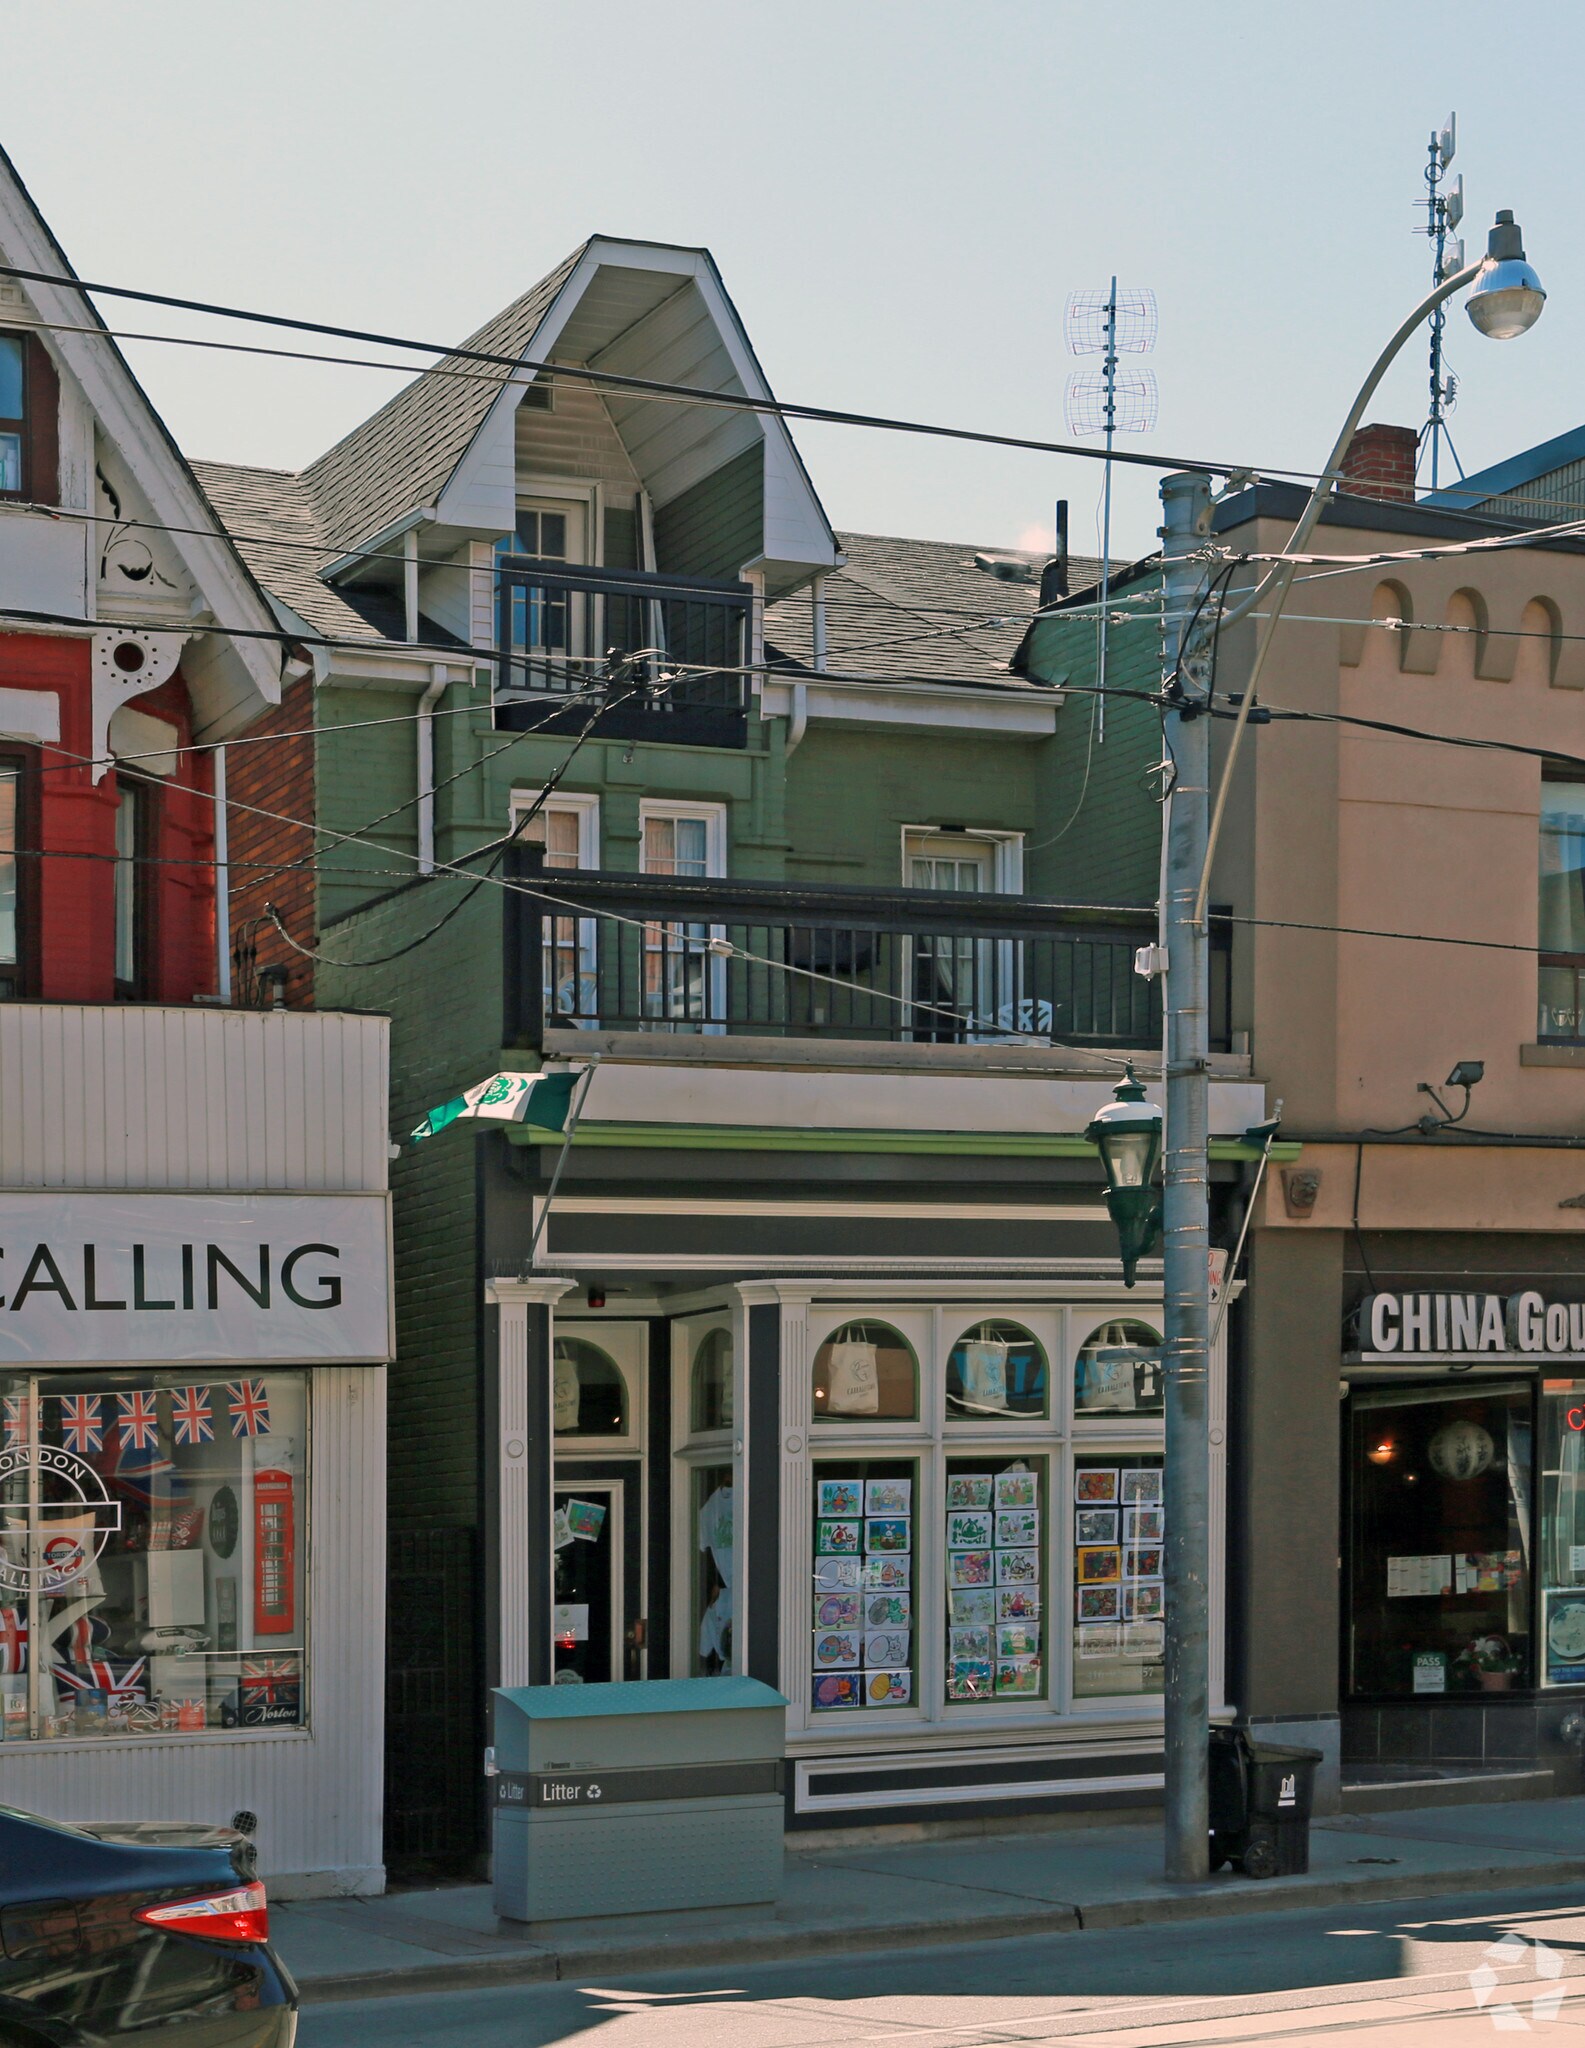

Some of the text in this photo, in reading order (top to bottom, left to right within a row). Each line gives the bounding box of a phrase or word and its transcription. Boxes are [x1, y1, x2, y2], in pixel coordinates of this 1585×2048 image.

[0, 1243, 342, 1311] ALLING
[1371, 1292, 1507, 1352] CHINA
[0, 1450, 86, 1480] ONDON
[0, 1566, 77, 1586] ALLING
[1416, 1656, 1441, 1666] PASS
[245, 1705, 297, 1724] Norton
[507, 1781, 524, 1800] Litter
[543, 1783, 581, 1801] Litter
